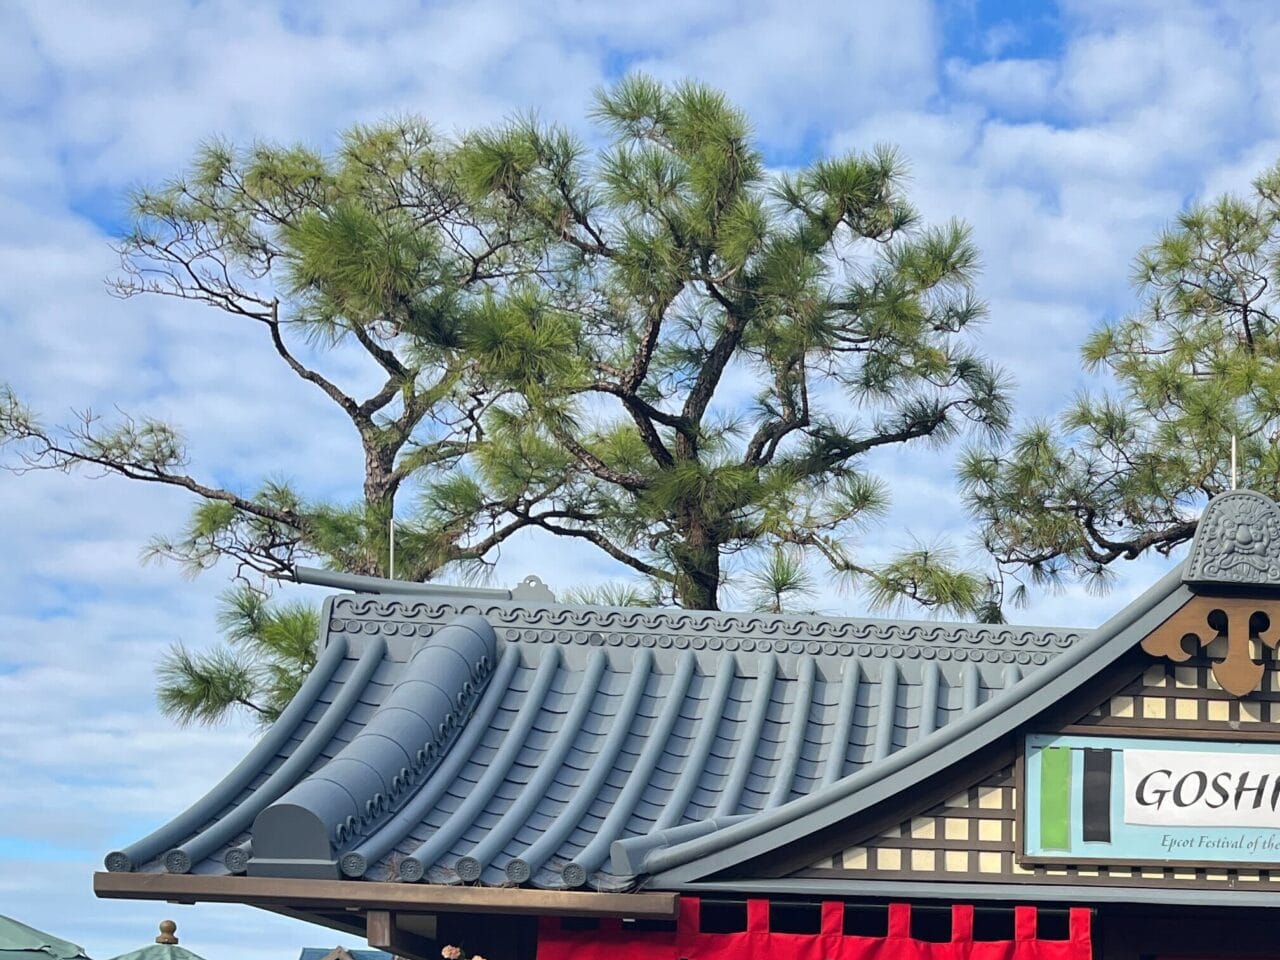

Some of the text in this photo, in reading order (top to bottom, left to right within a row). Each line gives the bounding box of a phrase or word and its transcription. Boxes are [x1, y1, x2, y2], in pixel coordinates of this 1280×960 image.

[1160, 834, 1195, 852] Epcot
[1198, 835, 1245, 849] Festival
[1246, 835, 1262, 854] of
[1262, 834, 1280, 850] the
